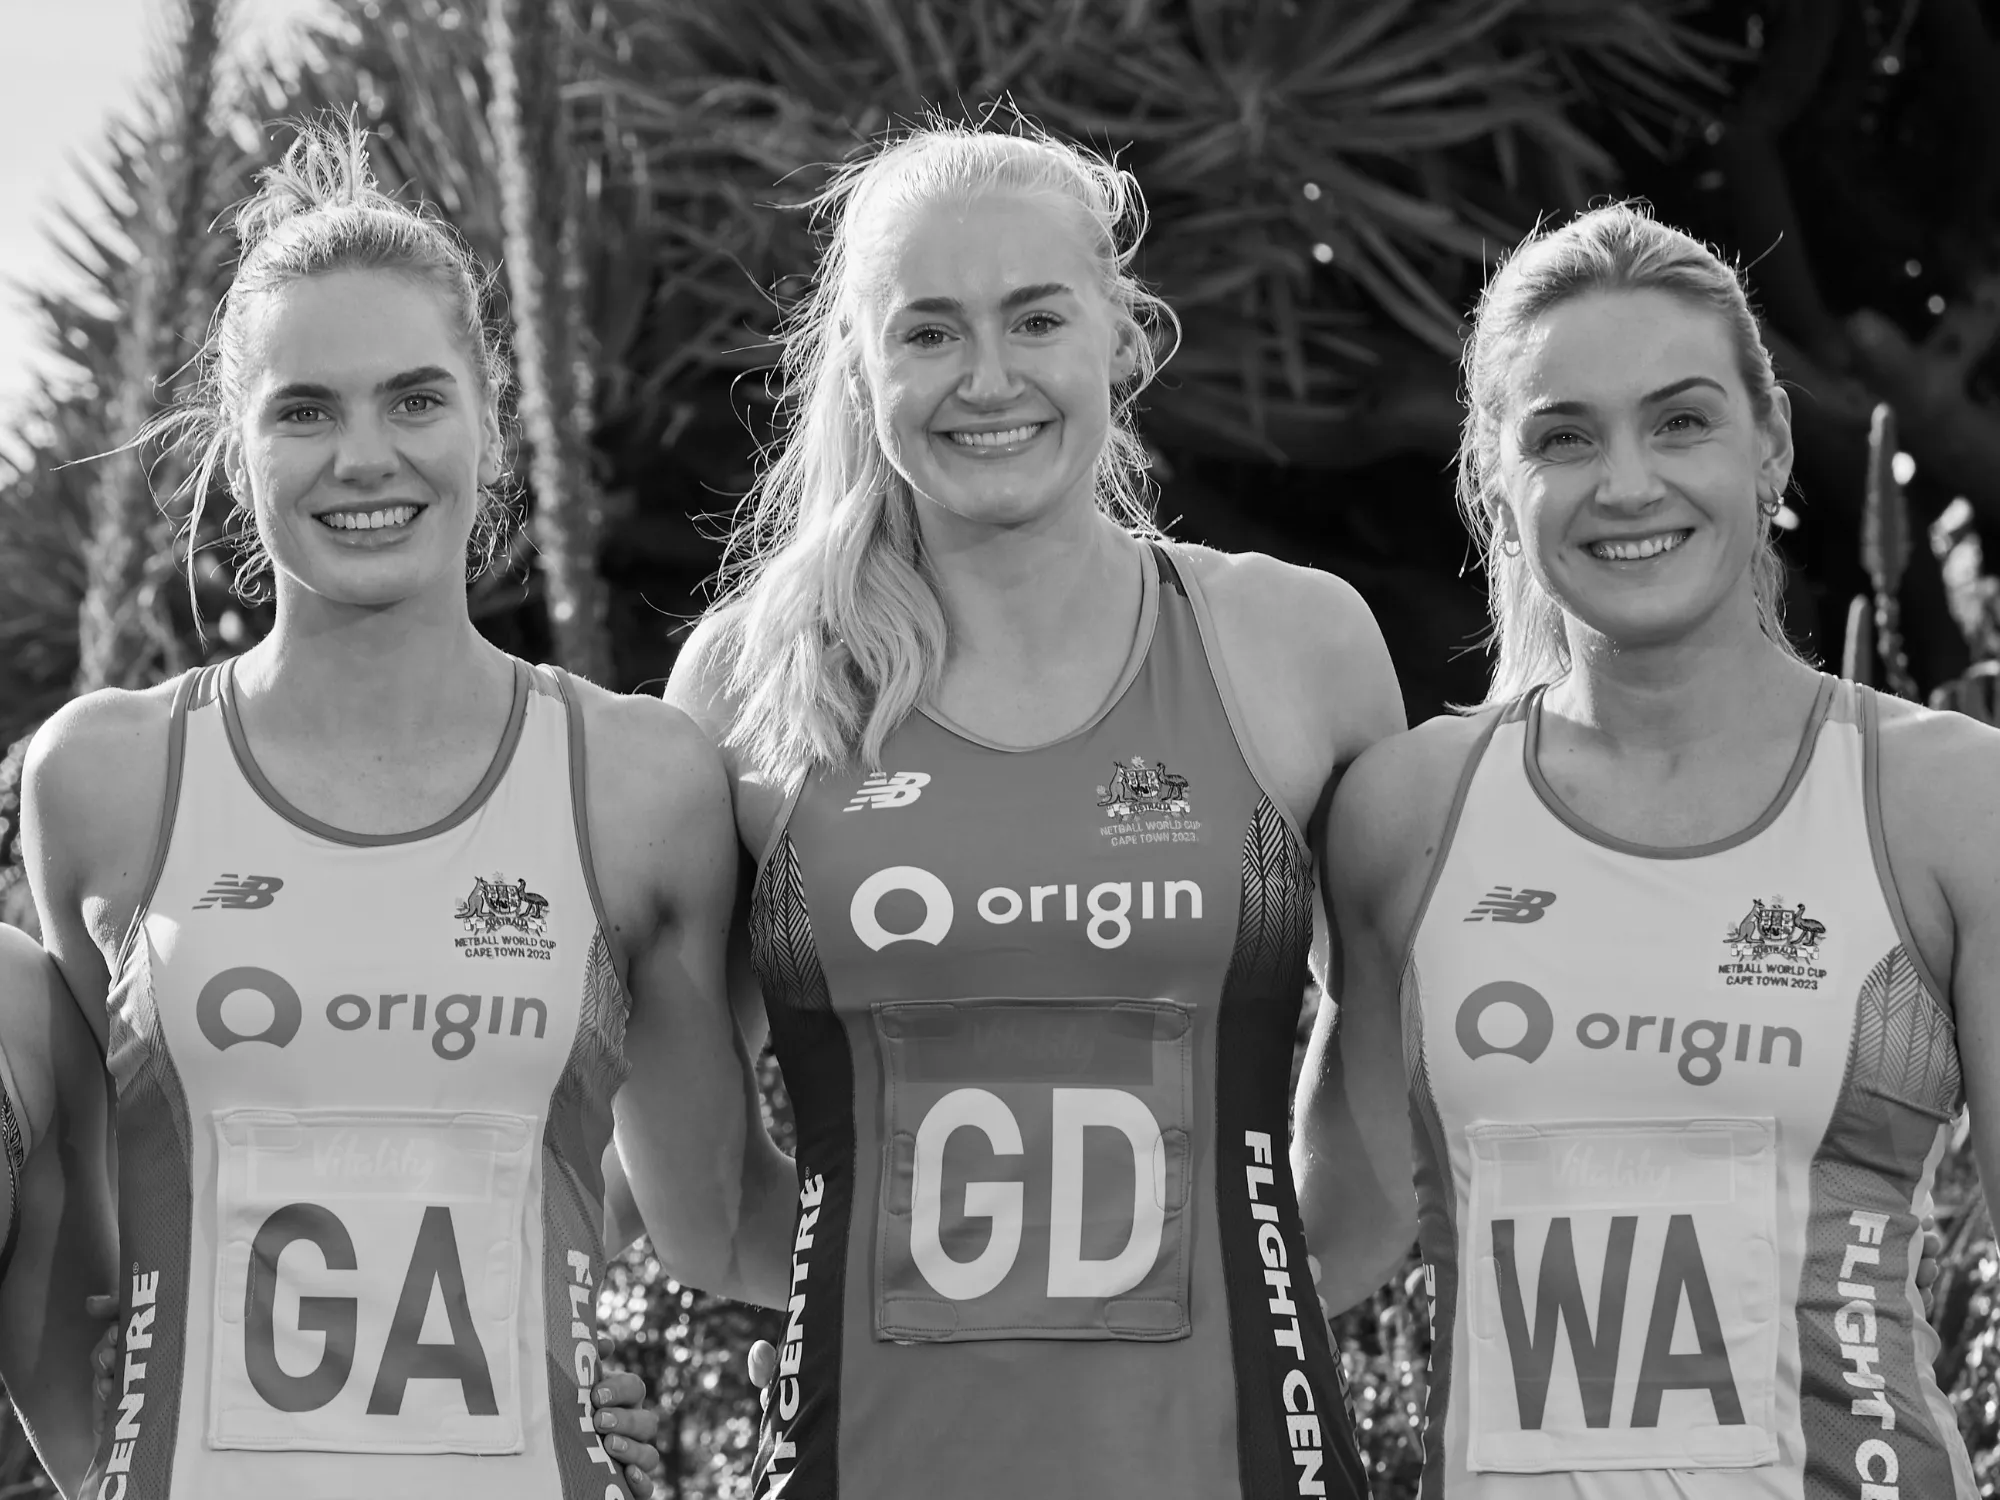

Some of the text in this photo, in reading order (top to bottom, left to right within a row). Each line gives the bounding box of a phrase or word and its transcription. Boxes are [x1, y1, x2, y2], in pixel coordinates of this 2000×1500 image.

[1100, 820, 1201, 836] NETBALL WORLD CUP
[1111, 834, 1138, 847] CAPE
[1140, 832, 1170, 844] TOWN
[455, 936, 557, 950] NETBALL WORLD CUP
[977, 880, 1203, 950] origin
[465, 947, 551, 961] CAPE TOWN 2023
[1718, 963, 1828, 979] NETBALL WORLD CUP
[1726, 975, 1819, 991] CAPE TOWN 2023
[326, 993, 548, 1061] origin
[1576, 1012, 1803, 1086] origin
[910, 1087, 1167, 1301] GD
[244, 1203, 499, 1416] GA
[780, 1174, 824, 1421] CENTRE
[1245, 1130, 1327, 1500] FLIGHT CEN
[1491, 1214, 1747, 1430] WA
[1834, 1210, 1896, 1430] FLIGHT
[567, 1250, 617, 1474] FLIGHT
